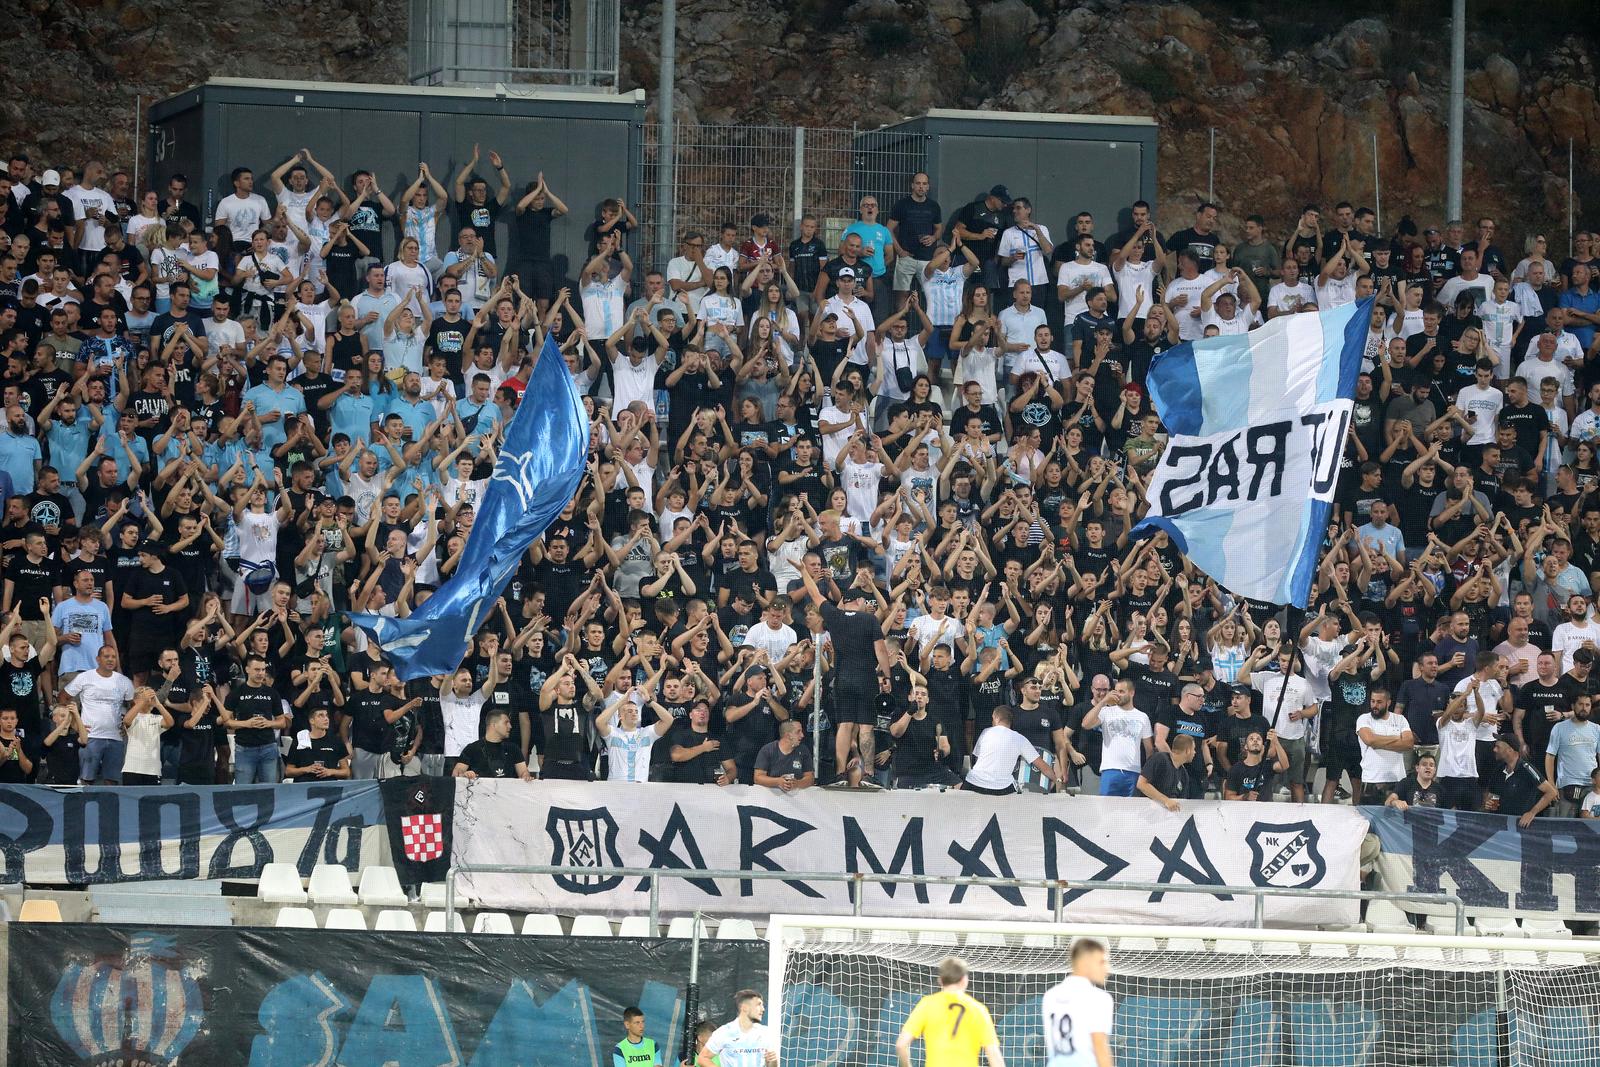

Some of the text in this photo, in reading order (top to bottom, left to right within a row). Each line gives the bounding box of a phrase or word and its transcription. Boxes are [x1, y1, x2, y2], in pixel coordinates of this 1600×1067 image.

[634, 802, 1235, 907] ARMADA
[1260, 834, 1310, 880] RIJEKA
[1265, 836, 1280, 847] NK
[948, 1002, 967, 1040] 7
